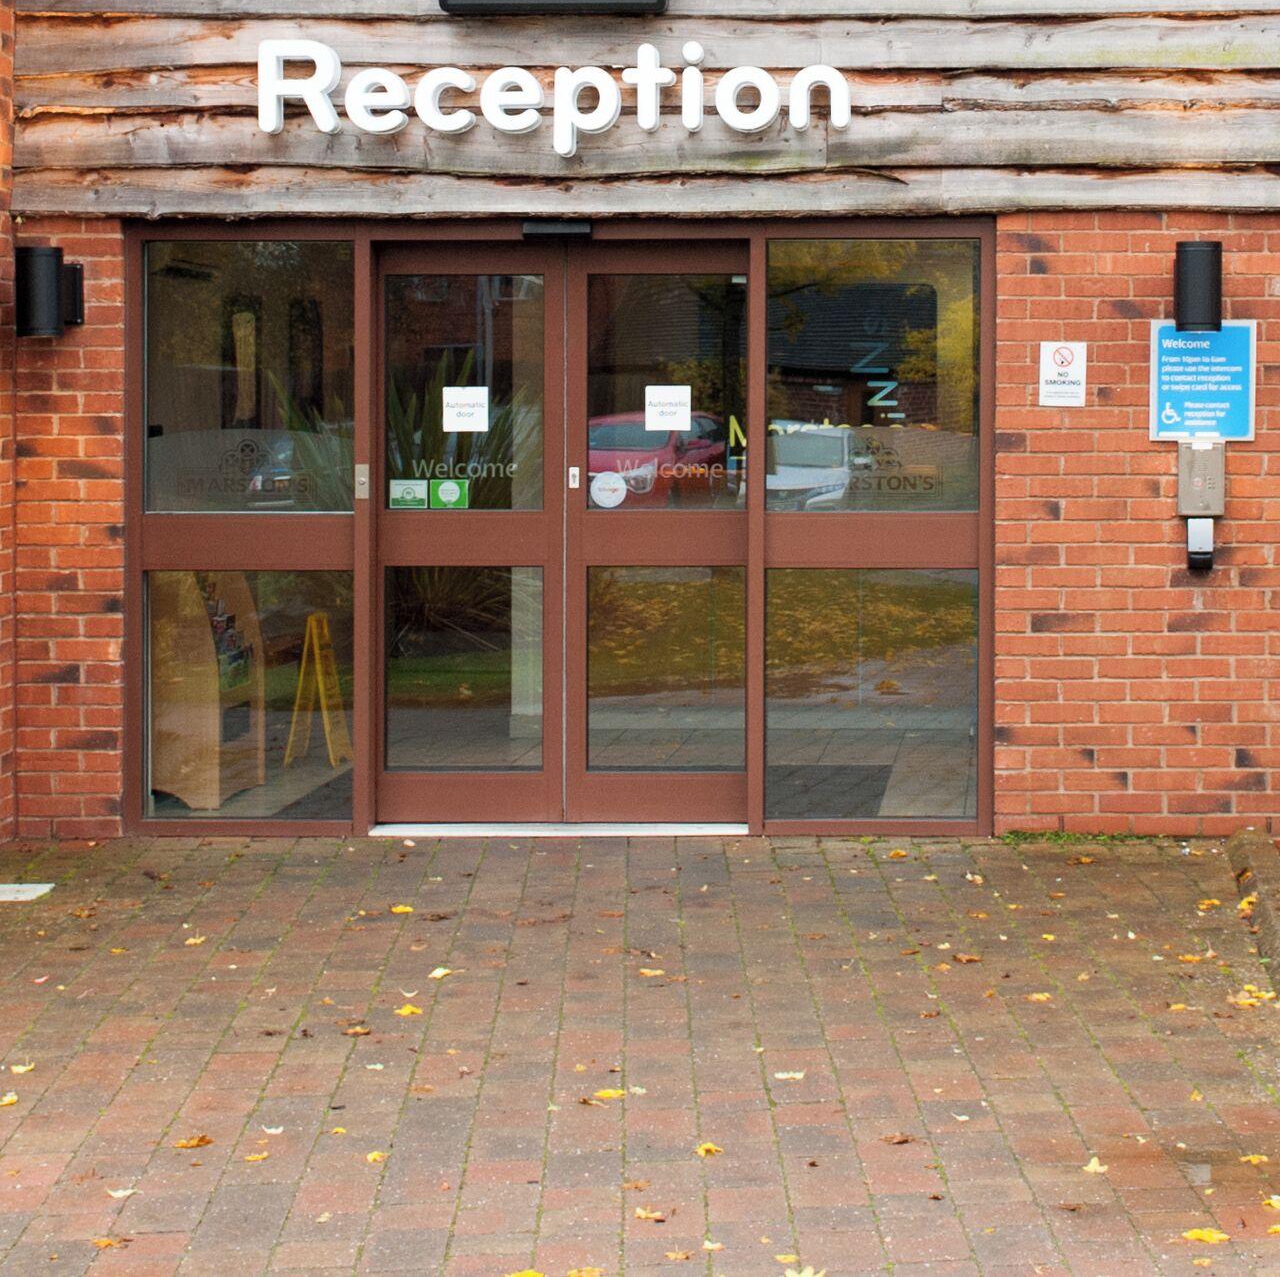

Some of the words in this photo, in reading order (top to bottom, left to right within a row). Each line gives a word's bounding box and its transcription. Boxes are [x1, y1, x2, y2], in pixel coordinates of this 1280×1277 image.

[258, 39, 852, 158] Reception
[1161, 338, 1211, 349] Welcome
[1197, 374, 1231, 383] reception
[1208, 383, 1218, 391] for
[446, 401, 485, 409] Automatic
[648, 400, 689, 408] Automatic
[456, 408, 475, 417] door
[658, 409, 677, 417] door
[412, 456, 519, 479] Welcome
